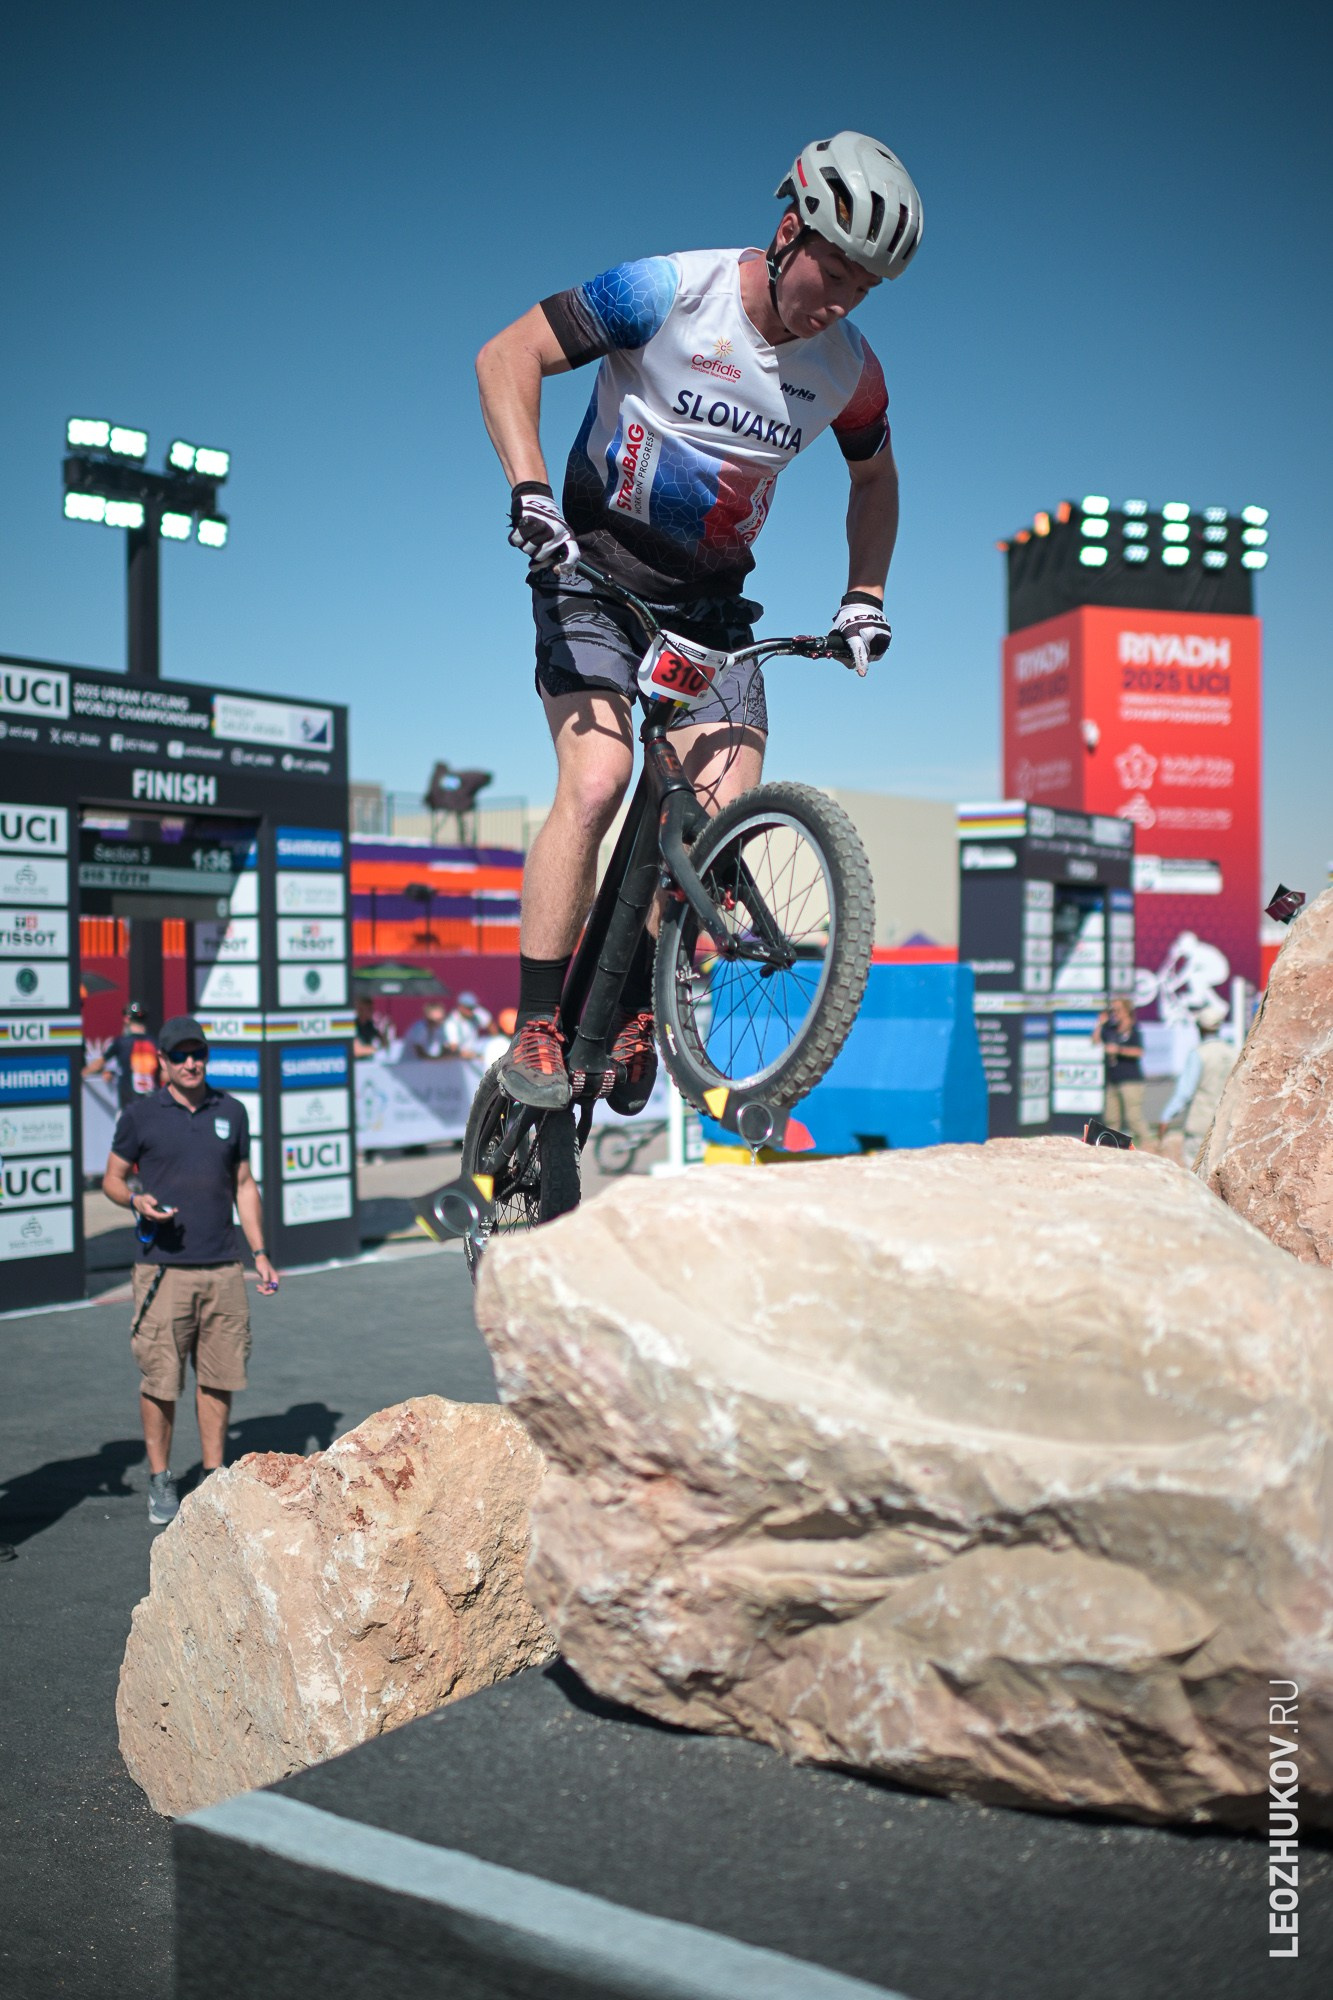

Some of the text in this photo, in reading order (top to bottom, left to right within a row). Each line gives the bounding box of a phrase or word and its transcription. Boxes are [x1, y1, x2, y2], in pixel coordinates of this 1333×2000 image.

[691, 353, 742, 380] Cofidis
[780, 382, 817, 401] NyNa
[672, 389, 802, 454] SLOVAKIA
[616, 423, 645, 511] STRABAG
[638, 430, 655, 479] PROGRESS
[636, 480, 644, 497] ON
[1118, 630, 1231, 669] RIYADH
[661, 658, 708, 692] 310
[1122, 667, 1230, 695] 2025 UCI
[4, 675, 62, 708] UCI
[133, 768, 216, 806] FINISH
[0, 813, 57, 844] UCI
[93, 843, 140, 864] Section
[11, 1023, 44, 1041] UCI
[213, 1020, 239, 1035] UCI
[300, 1019, 326, 1034] UCI
[282, 1056, 346, 1076] SHIMANO
[298, 1143, 341, 1169] UCI
[5, 1166, 62, 1198] UCI
